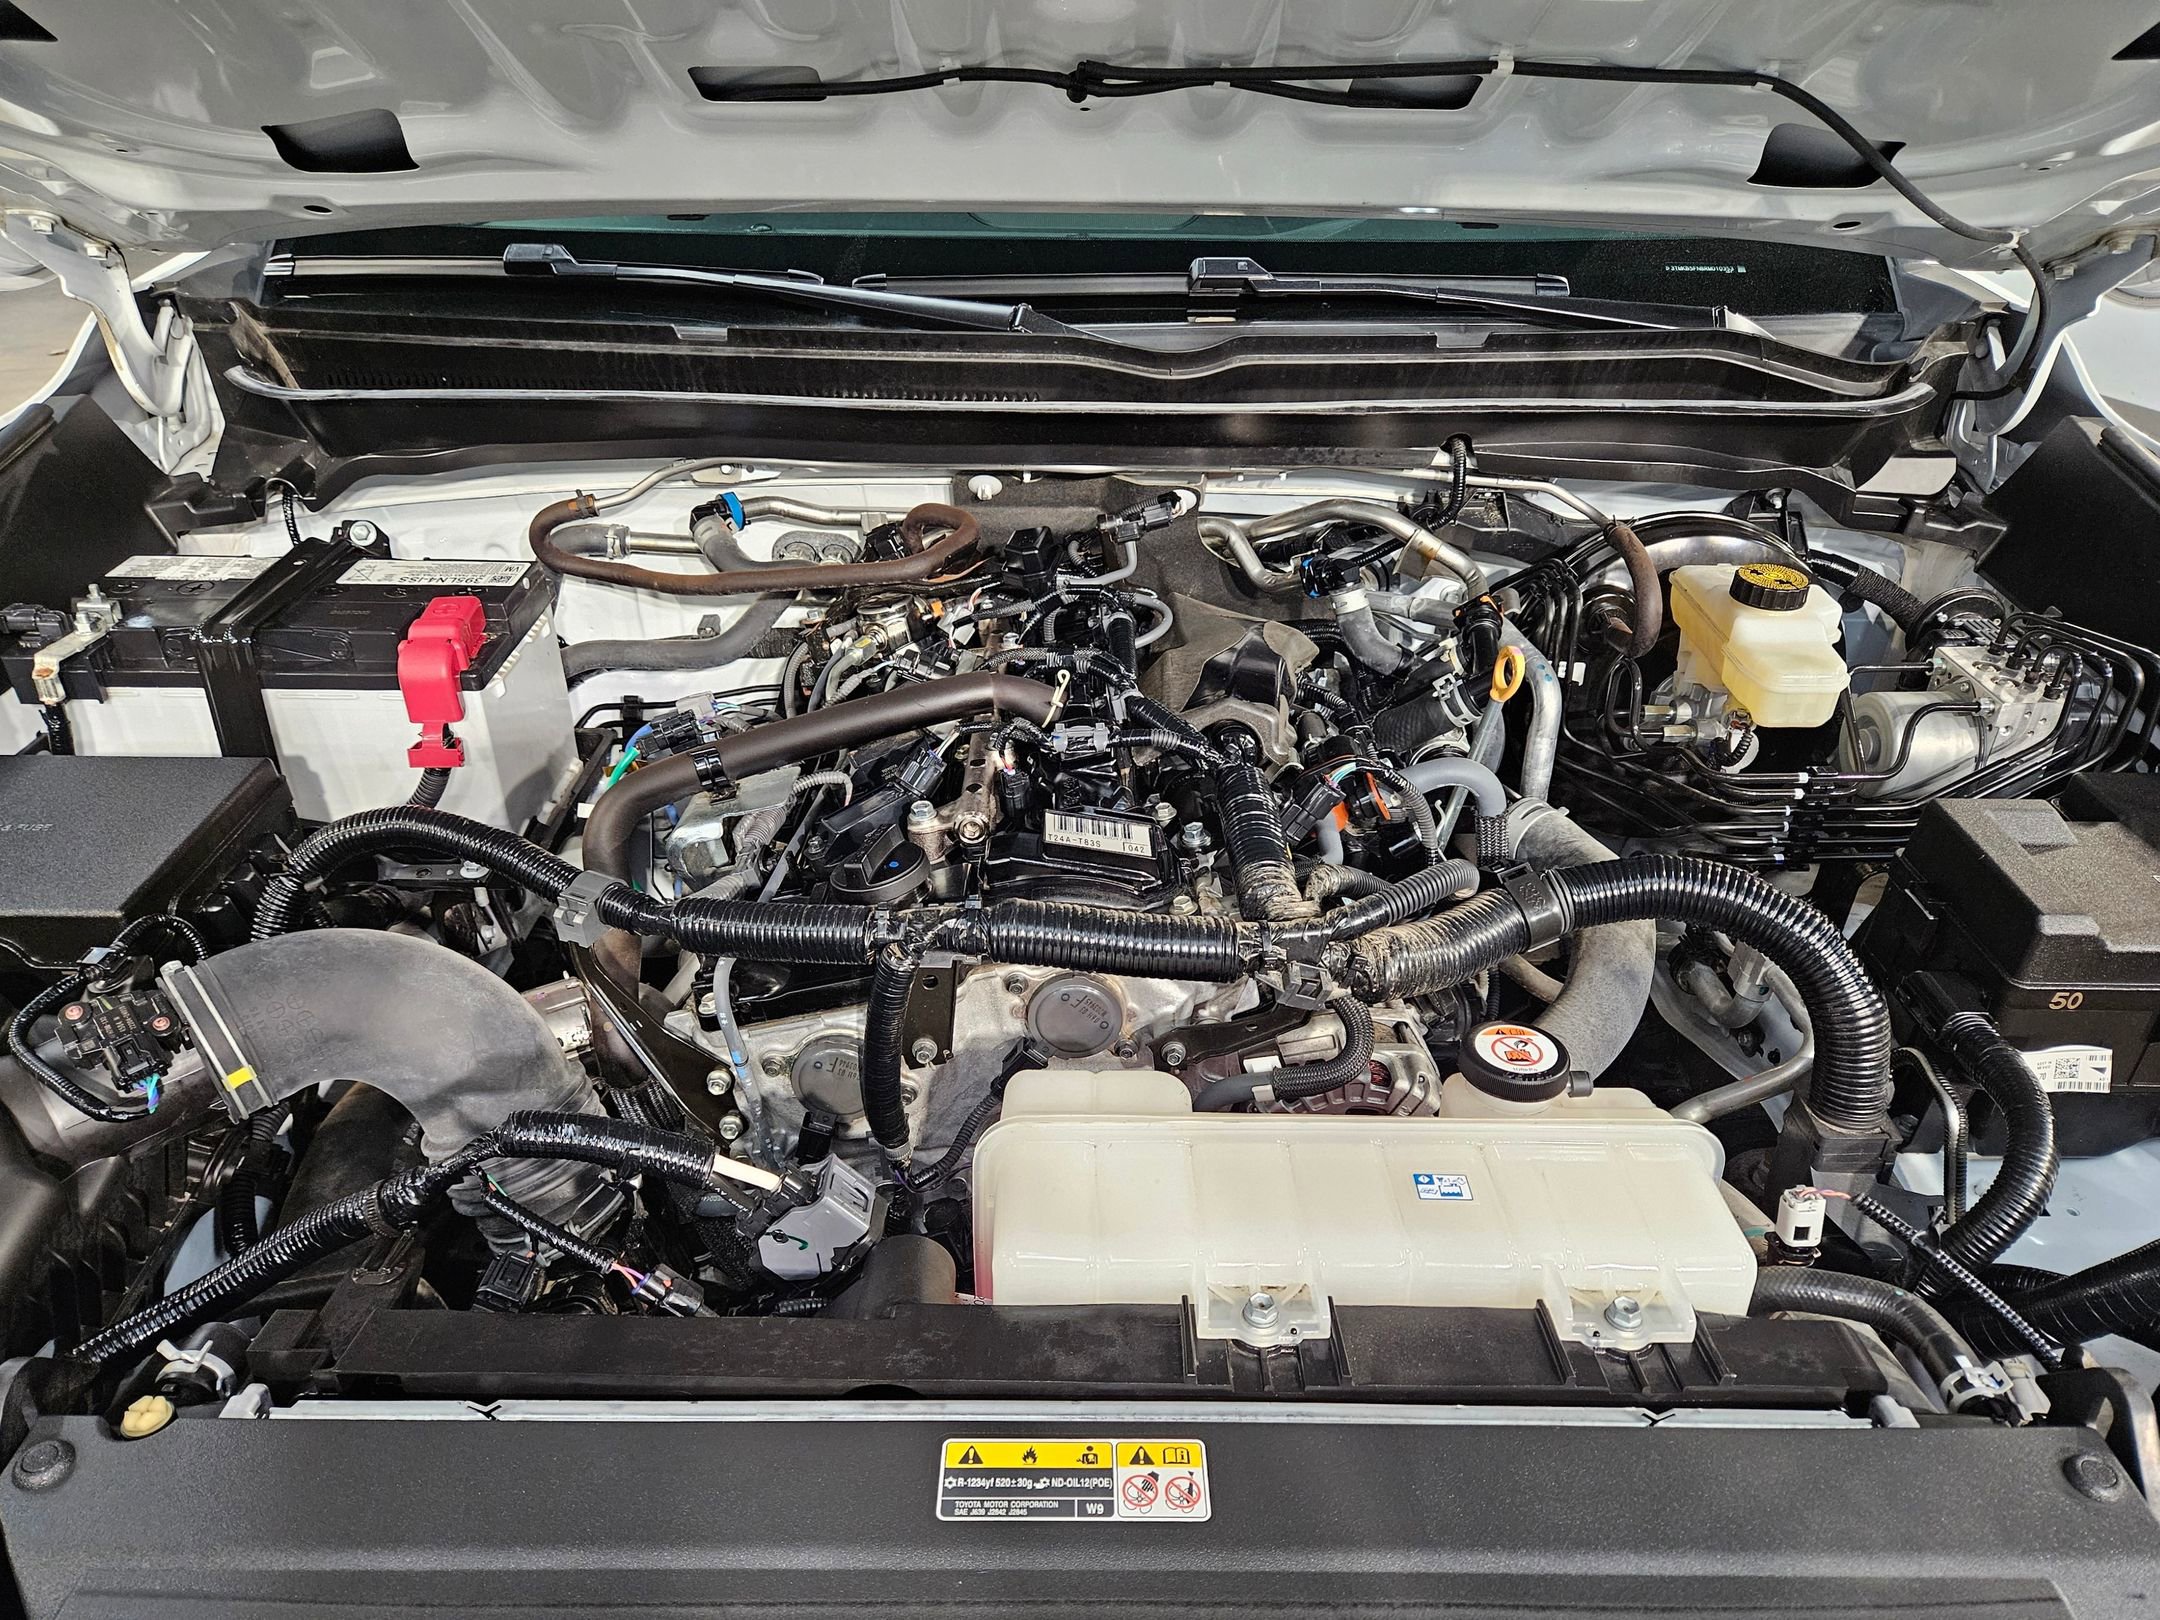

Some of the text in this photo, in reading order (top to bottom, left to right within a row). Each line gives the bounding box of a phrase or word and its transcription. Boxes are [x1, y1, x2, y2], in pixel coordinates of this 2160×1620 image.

[1048, 833, 1101, 848] T24A-T83S
[1127, 845, 1145, 854] 042
[2048, 991, 2084, 1010] 50
[957, 1477, 1113, 1489] R-1234yf 520±30g ND-OIL12(POE)
[954, 1500, 1059, 1509] TOYOTA MOTOR CORPORATION
[1086, 1503, 1104, 1515] W9
[954, 1508, 968, 1516] SAE
[970, 1508, 986, 1516] J639
